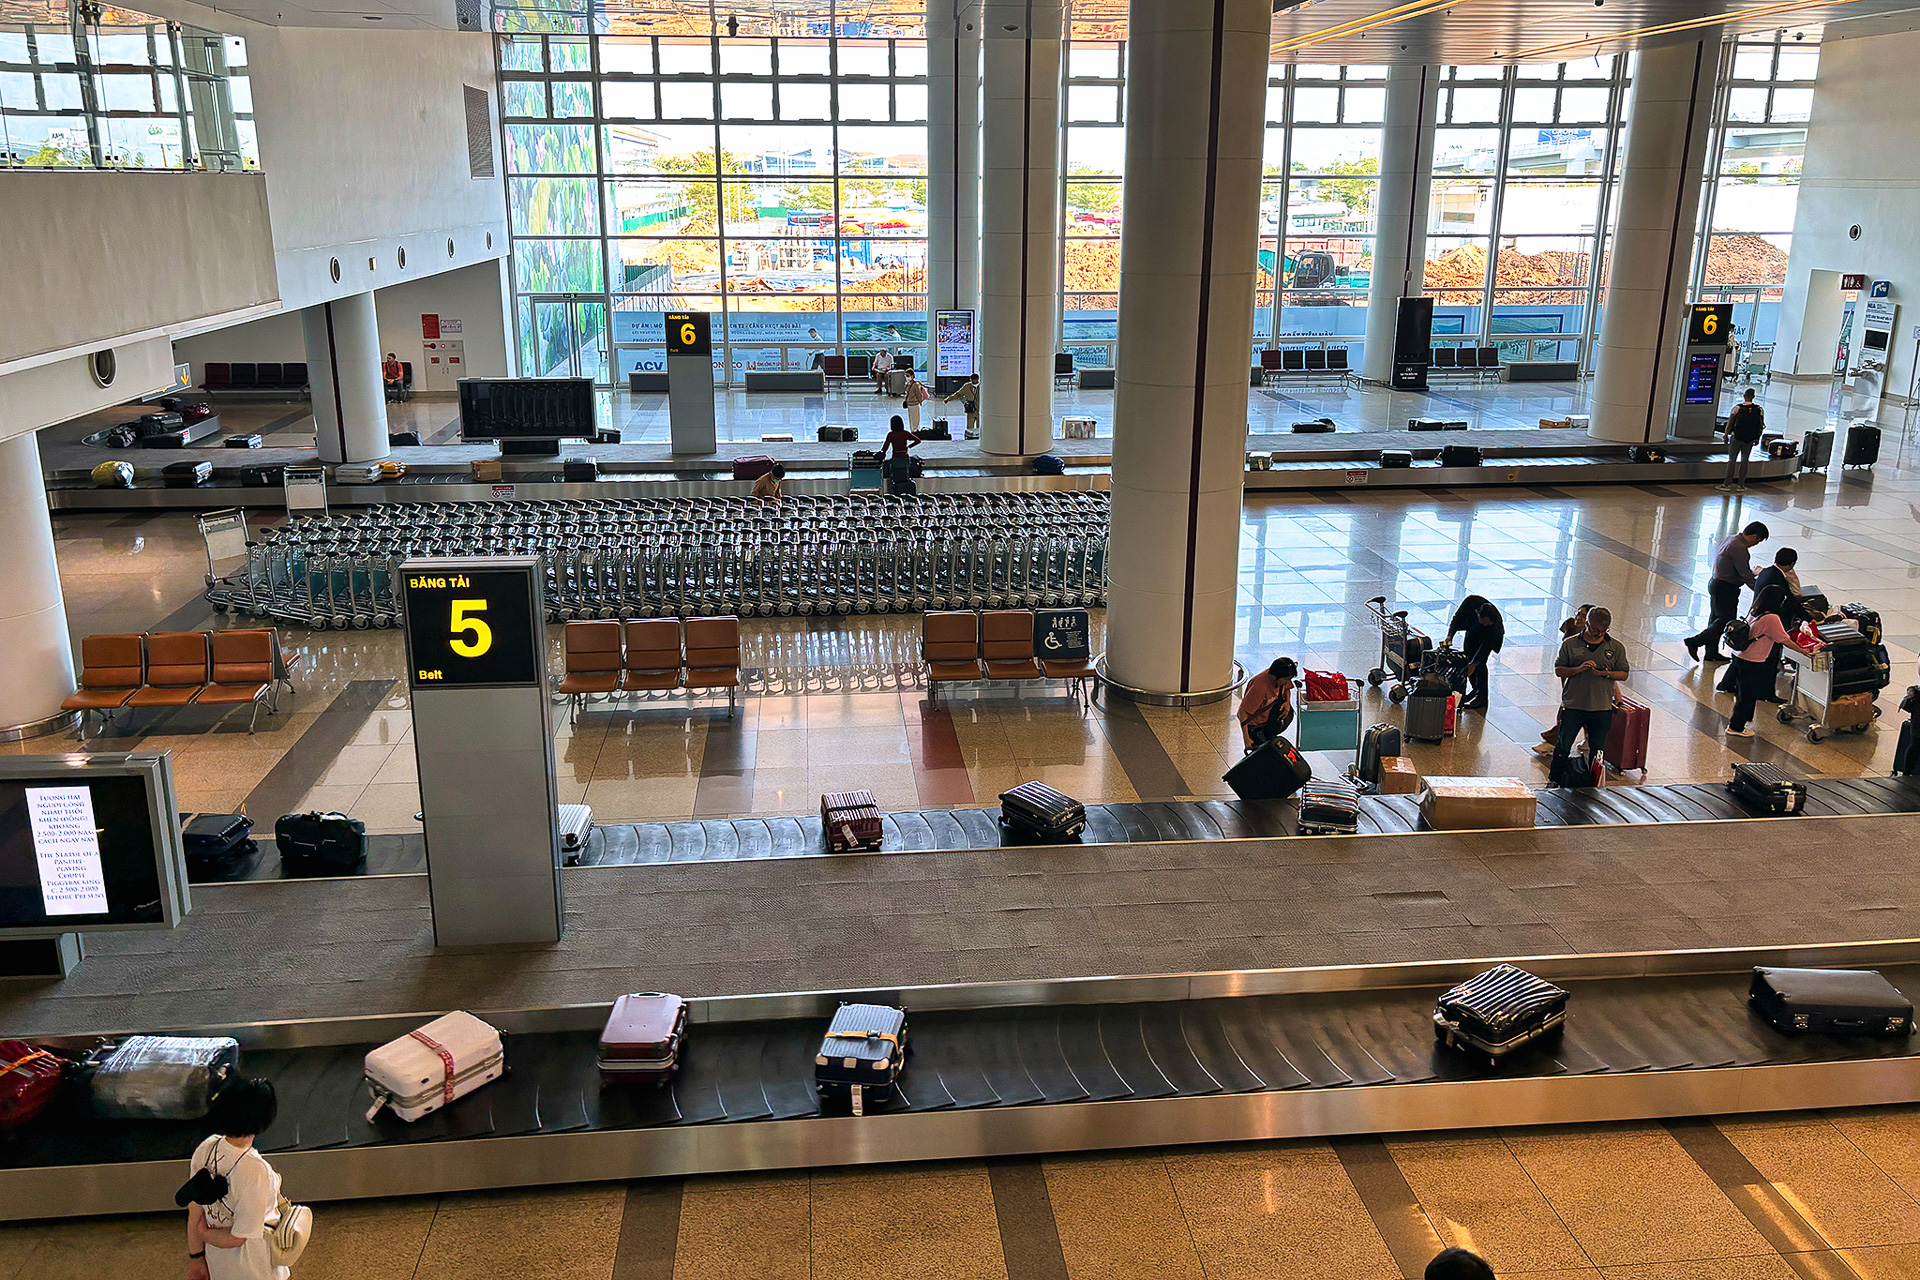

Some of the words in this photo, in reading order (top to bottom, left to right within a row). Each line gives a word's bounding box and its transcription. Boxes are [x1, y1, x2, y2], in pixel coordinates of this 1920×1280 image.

[1703, 314, 1718, 335] 6
[680, 323, 696, 345] 6
[635, 361, 664, 371] ACV
[410, 576, 446, 589] BĂNG
[449, 575, 470, 588] TẢI
[449, 599, 493, 658] 5
[419, 669, 443, 680] Belt
